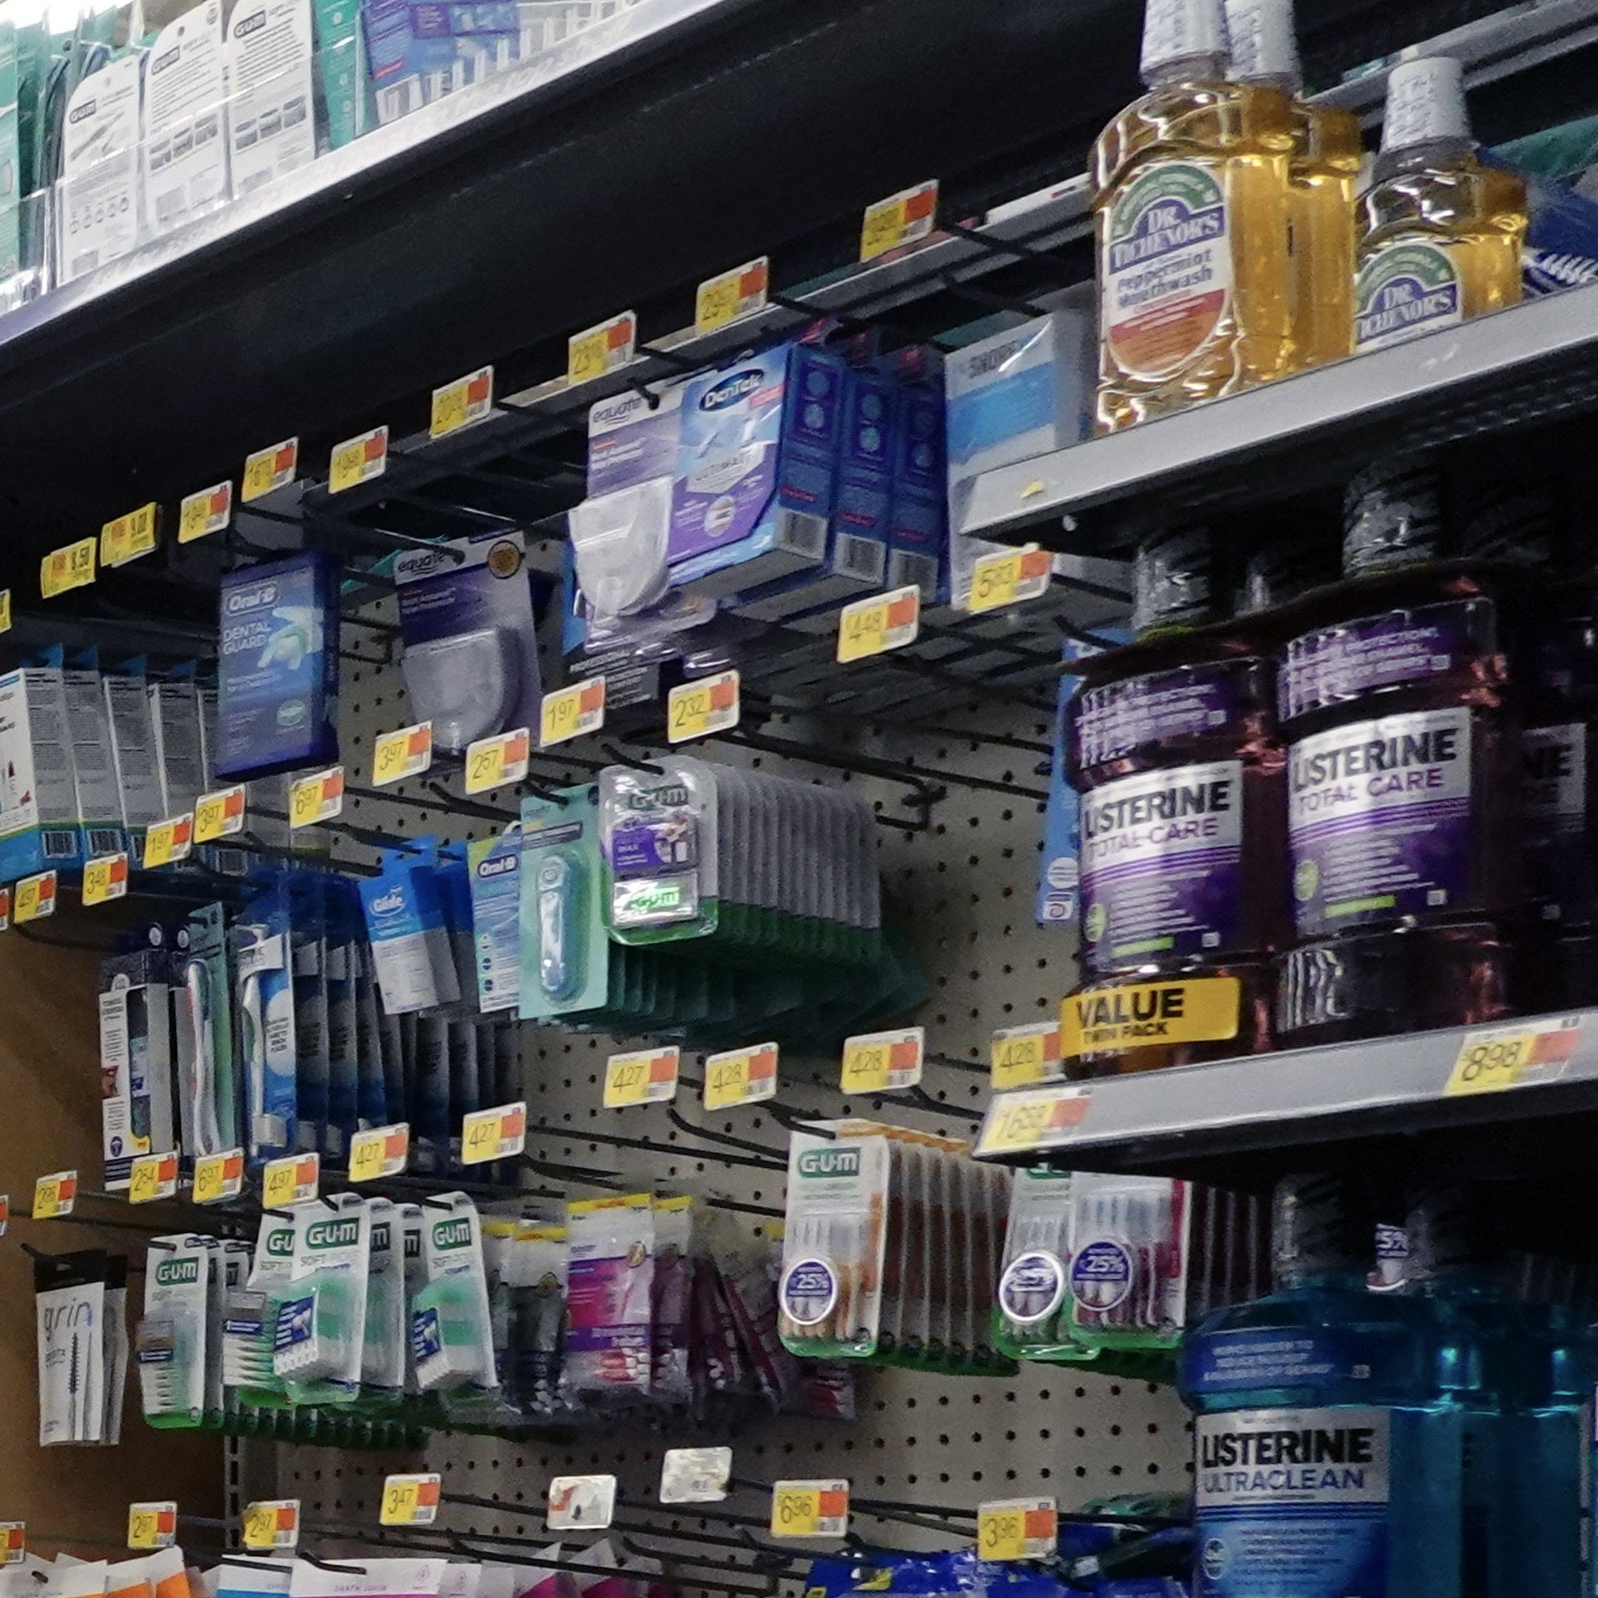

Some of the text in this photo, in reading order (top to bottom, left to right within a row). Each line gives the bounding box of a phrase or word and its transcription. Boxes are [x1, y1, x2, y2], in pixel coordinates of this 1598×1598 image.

[398, 551, 447, 574] equate
[223, 621, 271, 643] DENTAL
[223, 634, 266, 655] GUARD
[1293, 728, 1458, 791] LISTERINE
[1301, 768, 1444, 813] TOTAL CARE
[1085, 781, 1231, 838] LISTERINE
[1150, 818, 1218, 844] CARE
[1077, 987, 1185, 1023] VALUE
[1083, 1020, 1168, 1045] TWIN PACK
[1202, 1427, 1375, 1469] LISTERINE
[1203, 1468, 1365, 1494] ULTRACLEAN
